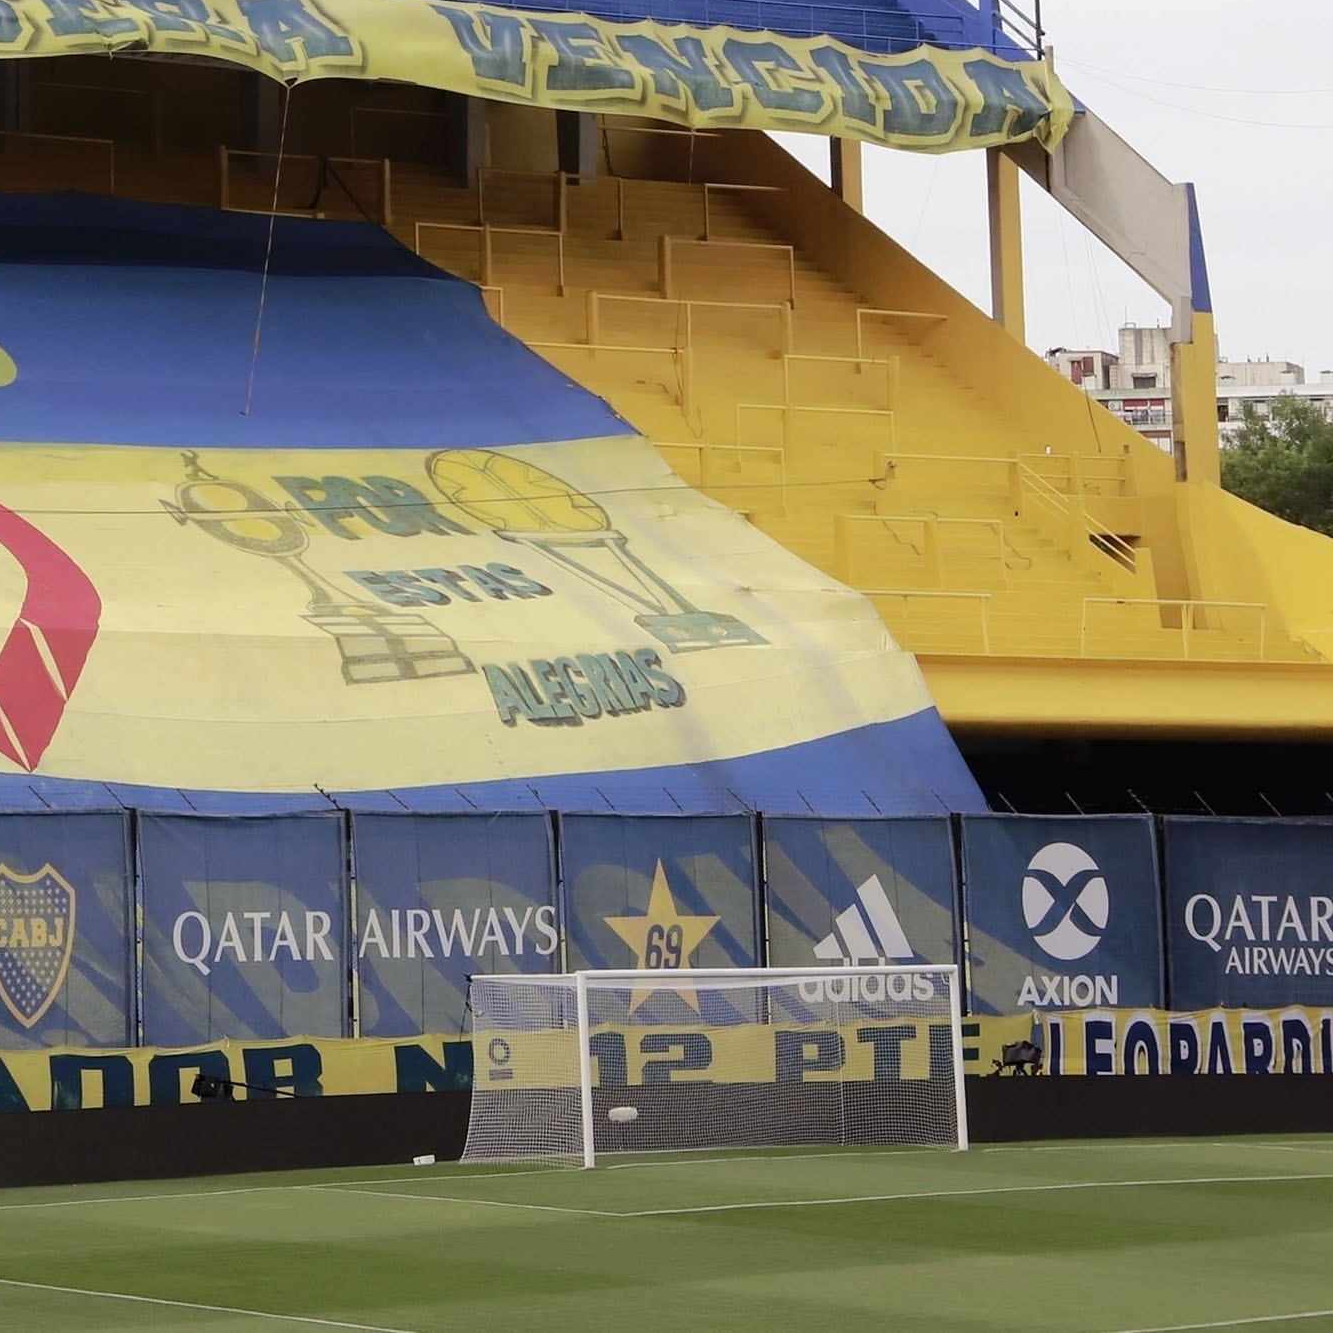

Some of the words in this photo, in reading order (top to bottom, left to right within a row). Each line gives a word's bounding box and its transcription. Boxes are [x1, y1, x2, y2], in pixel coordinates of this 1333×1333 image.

[433, 3, 1049, 138] VENCIDA
[271, 474, 477, 540] POR
[342, 561, 553, 607] ESTAS
[483, 647, 687, 728] ALEGRIAS
[172, 910, 334, 974] QATAR
[358, 905, 558, 960] AIRWAYS
[645, 924, 683, 969] 69
[1184, 893, 1333, 953] QATAR
[1017, 974, 1118, 1006] AXION
[1225, 946, 1333, 976] AIRWAYS
[588, 1031, 714, 1088] 12
